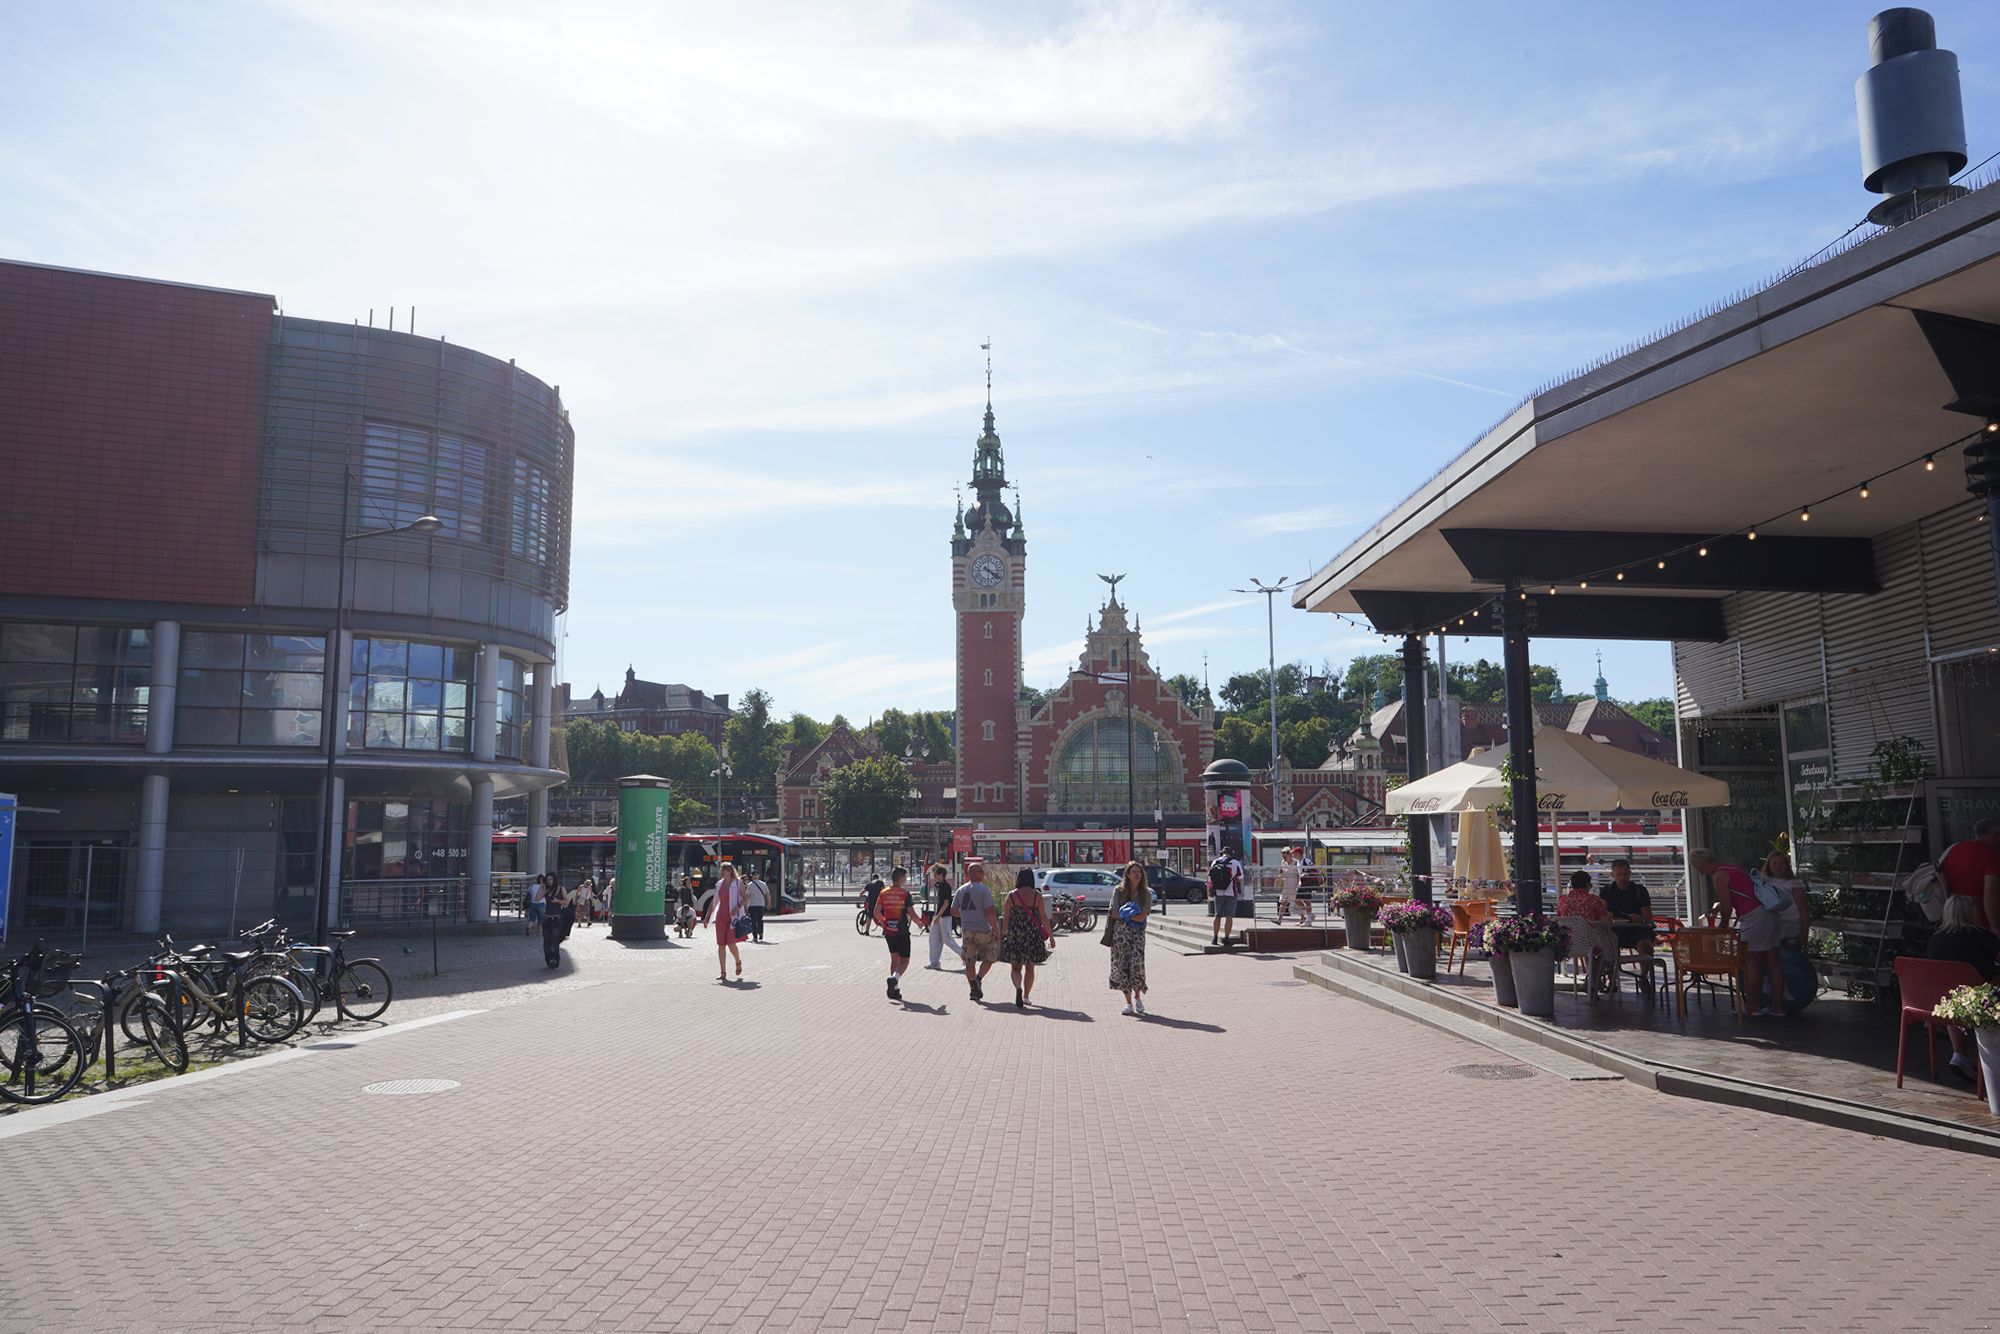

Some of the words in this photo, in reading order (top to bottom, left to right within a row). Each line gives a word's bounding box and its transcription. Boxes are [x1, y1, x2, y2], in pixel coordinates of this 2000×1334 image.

[655, 806, 663, 834] TEATR
[432, 848, 445, 858] +48
[448, 848, 459, 858] 500
[645, 832, 655, 862] PLAŻA
[645, 865, 654, 892] RANO
[653, 837, 662, 892] WIECZOREM
